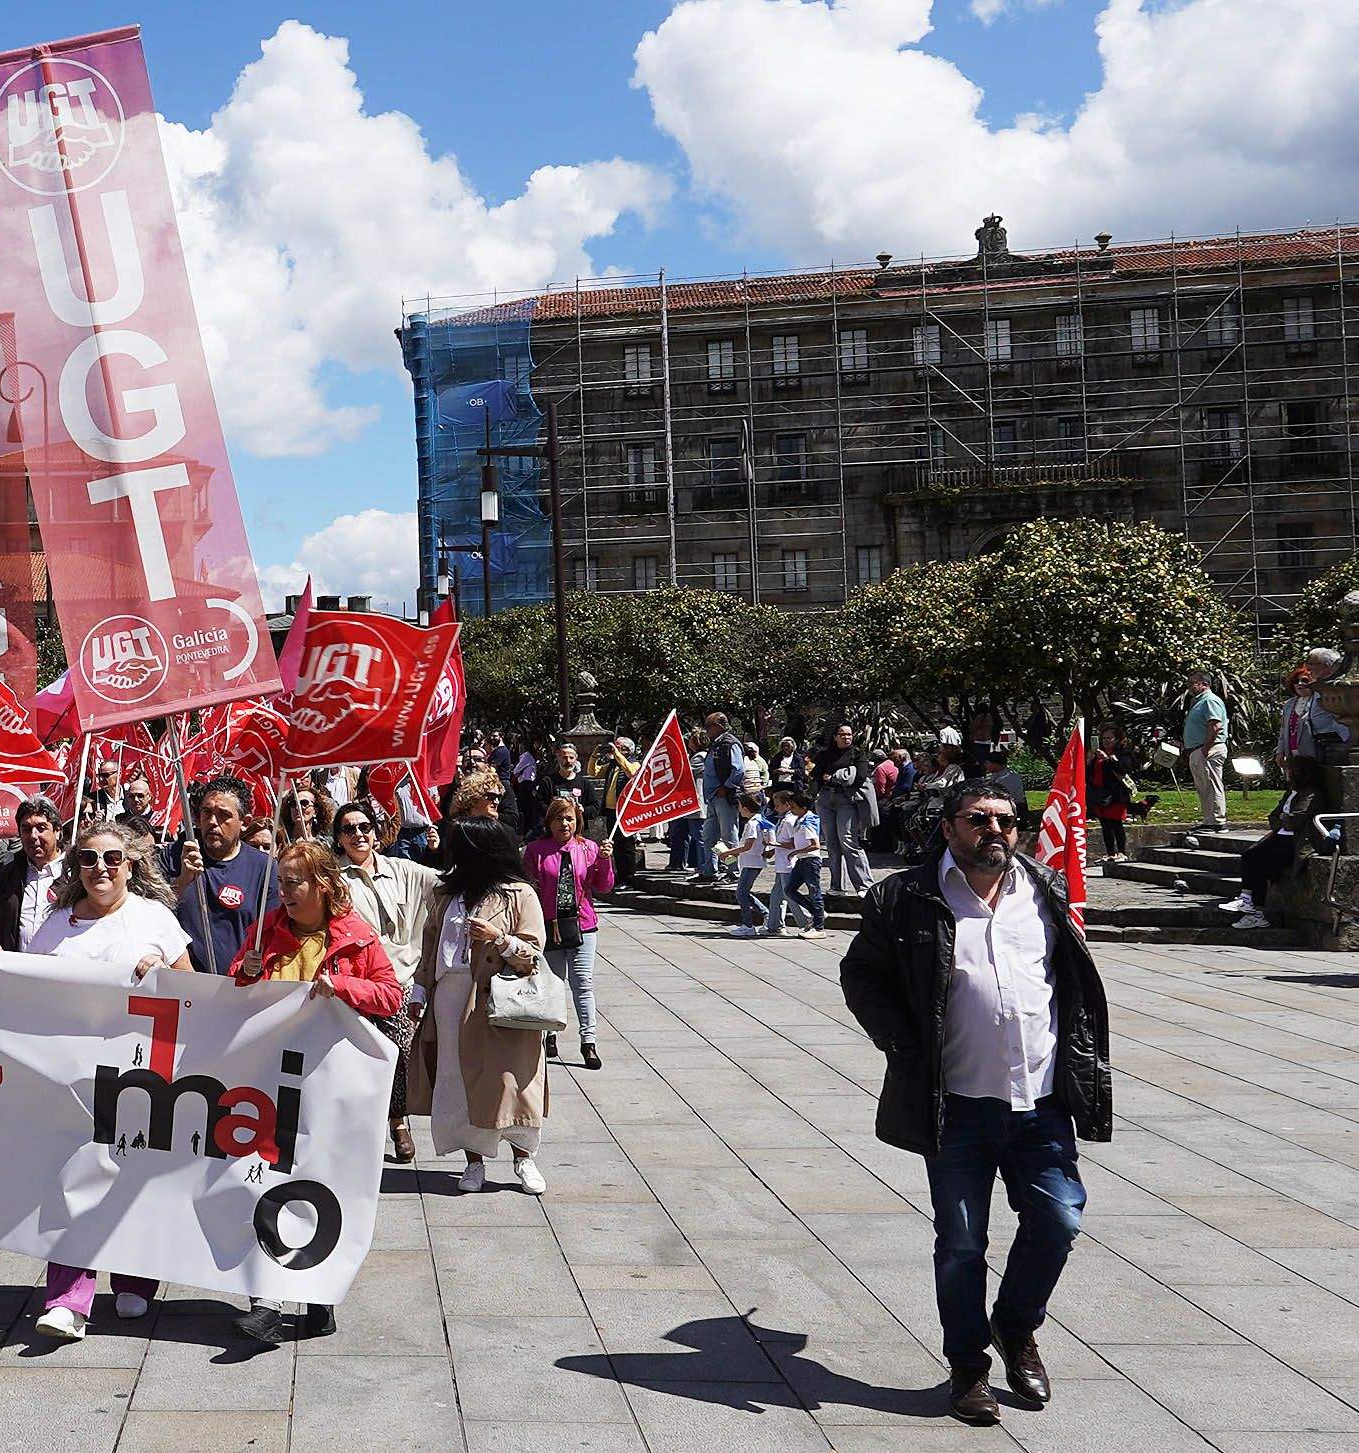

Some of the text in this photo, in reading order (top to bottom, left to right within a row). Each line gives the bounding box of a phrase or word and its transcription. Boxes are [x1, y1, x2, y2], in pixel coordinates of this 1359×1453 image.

[7, 77, 97, 145] UGT
[91, 626, 153, 671] UGT
[172, 626, 229, 650] Galicia
[175, 644, 230, 665] PONTEVEDRA
[625, 797, 694, 826] www.UGT.es
